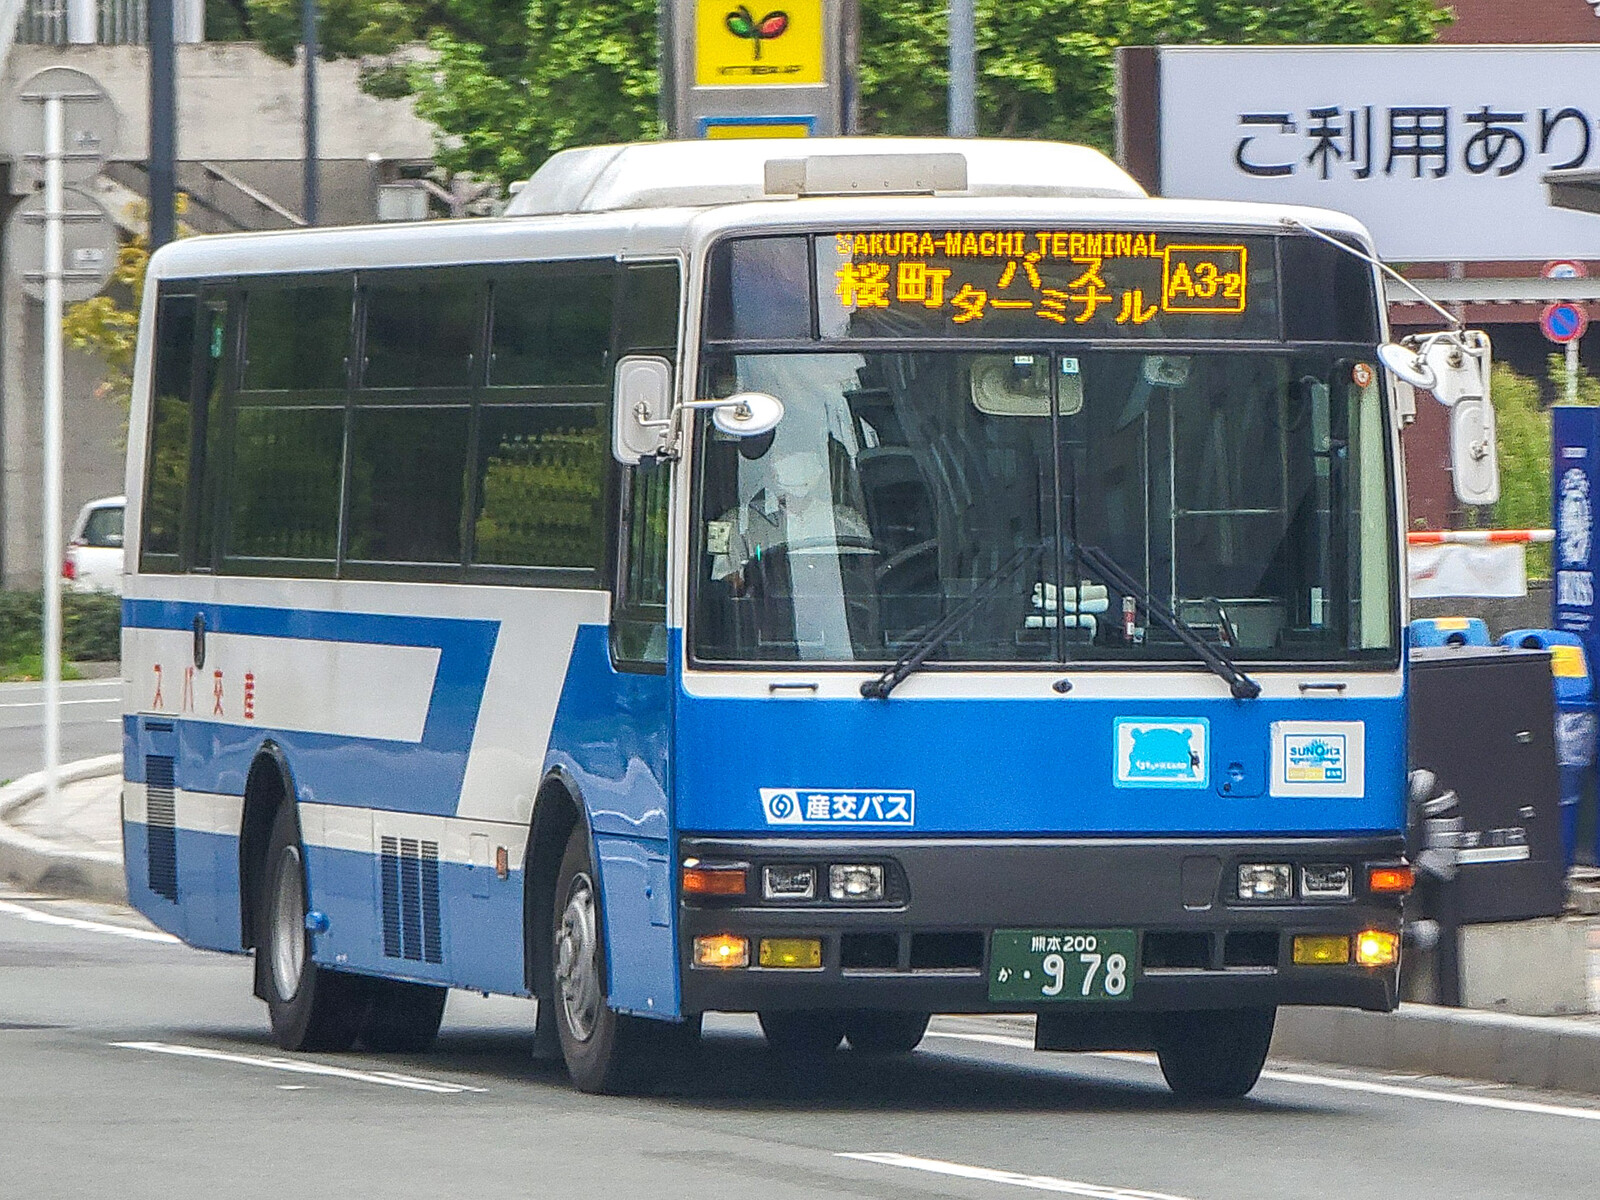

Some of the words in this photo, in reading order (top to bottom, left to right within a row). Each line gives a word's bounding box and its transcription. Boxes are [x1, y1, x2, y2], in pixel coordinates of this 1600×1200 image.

[1234, 104, 1600, 179] ご利用あり
[835, 232, 1025, 257] SAKURA-MACHI
[1035, 232, 1165, 257] TERMINAL
[835, 261, 952, 308] 桜町
[950, 282, 1158, 325] ターミナル
[806, 794, 909, 820] 産交バス
